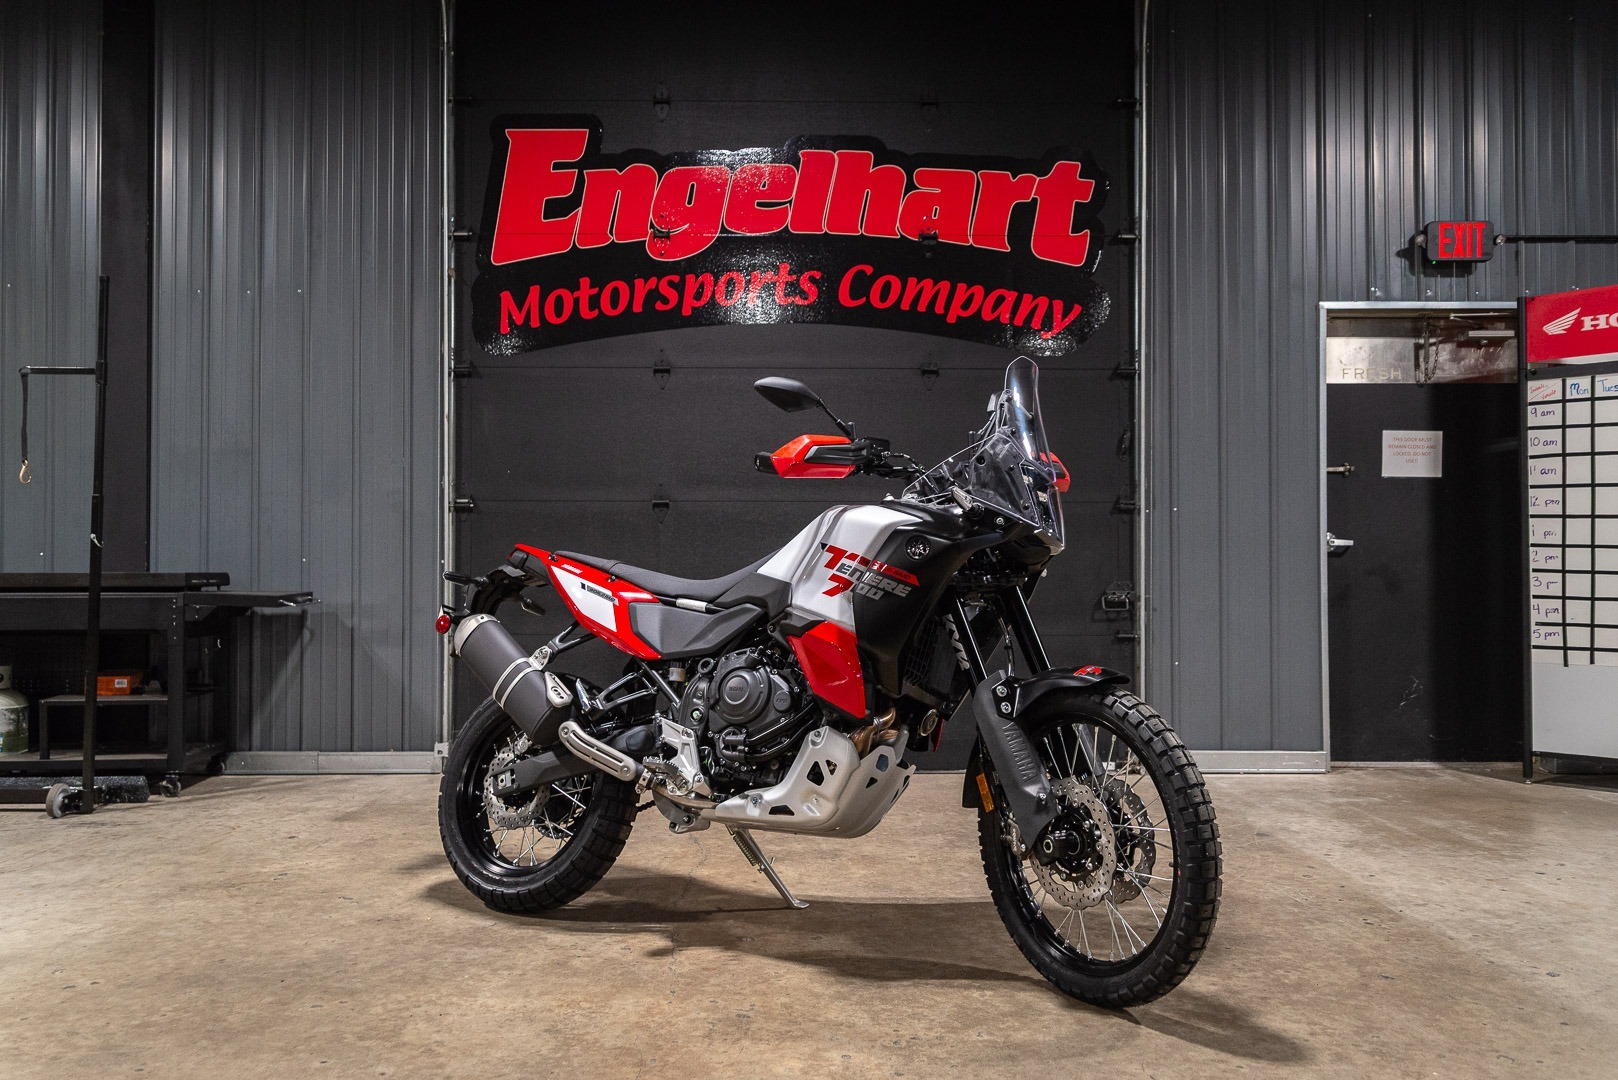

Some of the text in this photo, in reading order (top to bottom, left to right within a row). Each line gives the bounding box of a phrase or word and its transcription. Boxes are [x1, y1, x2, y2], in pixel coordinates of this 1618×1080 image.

[491, 128, 1096, 266] Engelhart
[1438, 221, 1487, 259] EXIT
[499, 262, 1083, 340] Motorsports Company
[1569, 382, 1590, 396] Mon
[1530, 406, 1556, 418] 9 am
[1529, 436, 1558, 447] 10 am
[1540, 467, 1557, 475] am
[1544, 498, 1560, 508] pm
[1532, 576, 1542, 587] 3
[1532, 603, 1560, 618] 4 pm
[1532, 628, 1560, 640] 5 pm
[1001, 721, 1039, 782] YAMAHA
